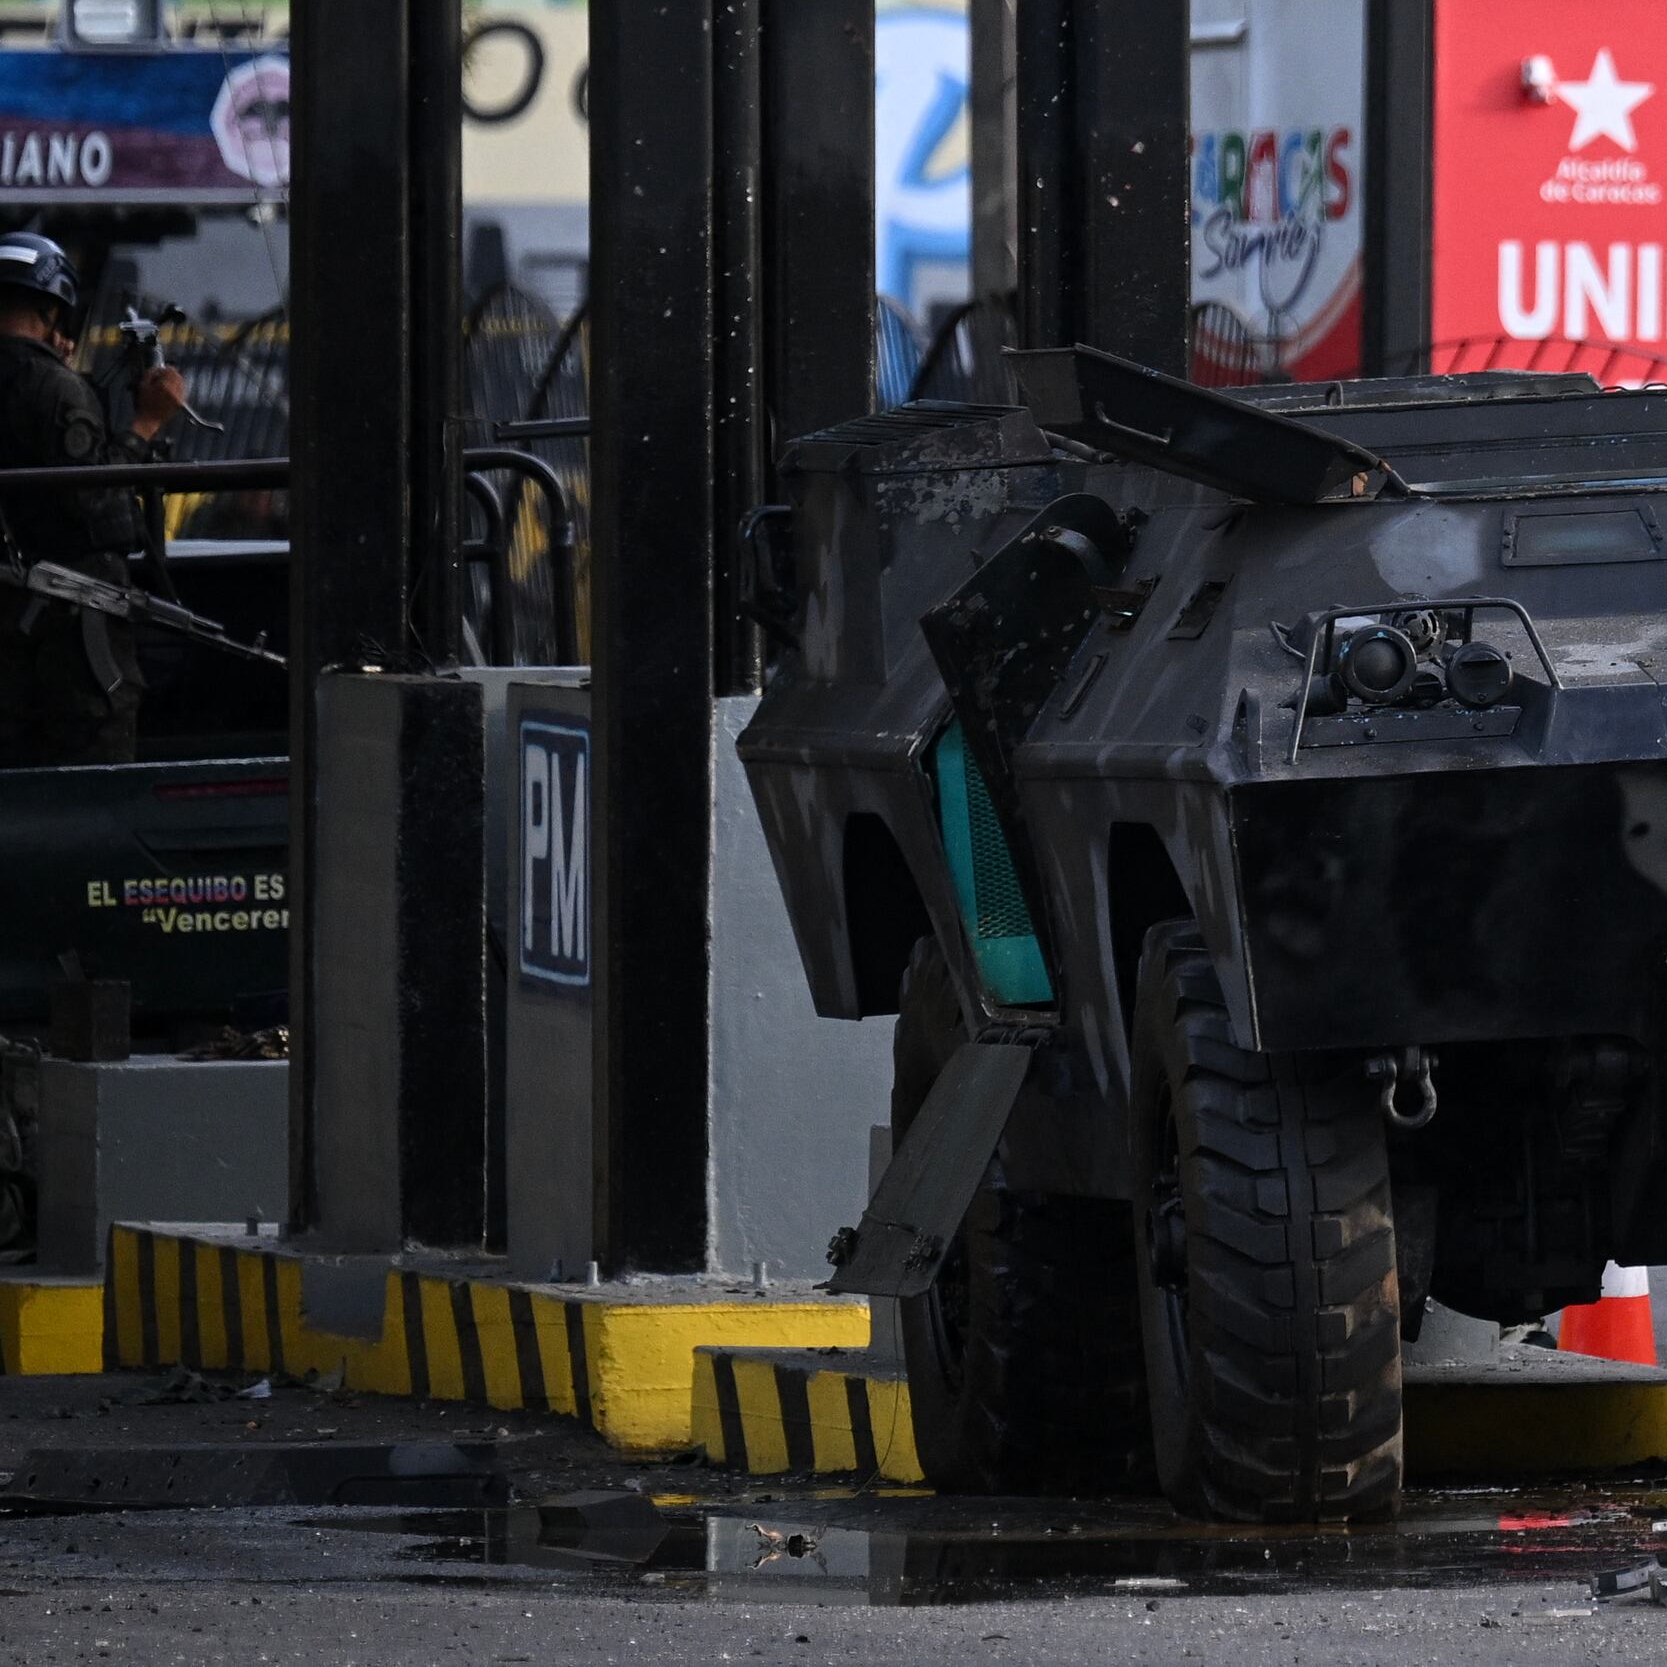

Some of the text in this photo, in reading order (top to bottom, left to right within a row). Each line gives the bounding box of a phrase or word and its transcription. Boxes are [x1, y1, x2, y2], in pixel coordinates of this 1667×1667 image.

[1190, 128, 1352, 223] ARACAS
[87, 873, 285, 907] EL ESEQUIBO ES
[523, 743, 586, 962] PM
